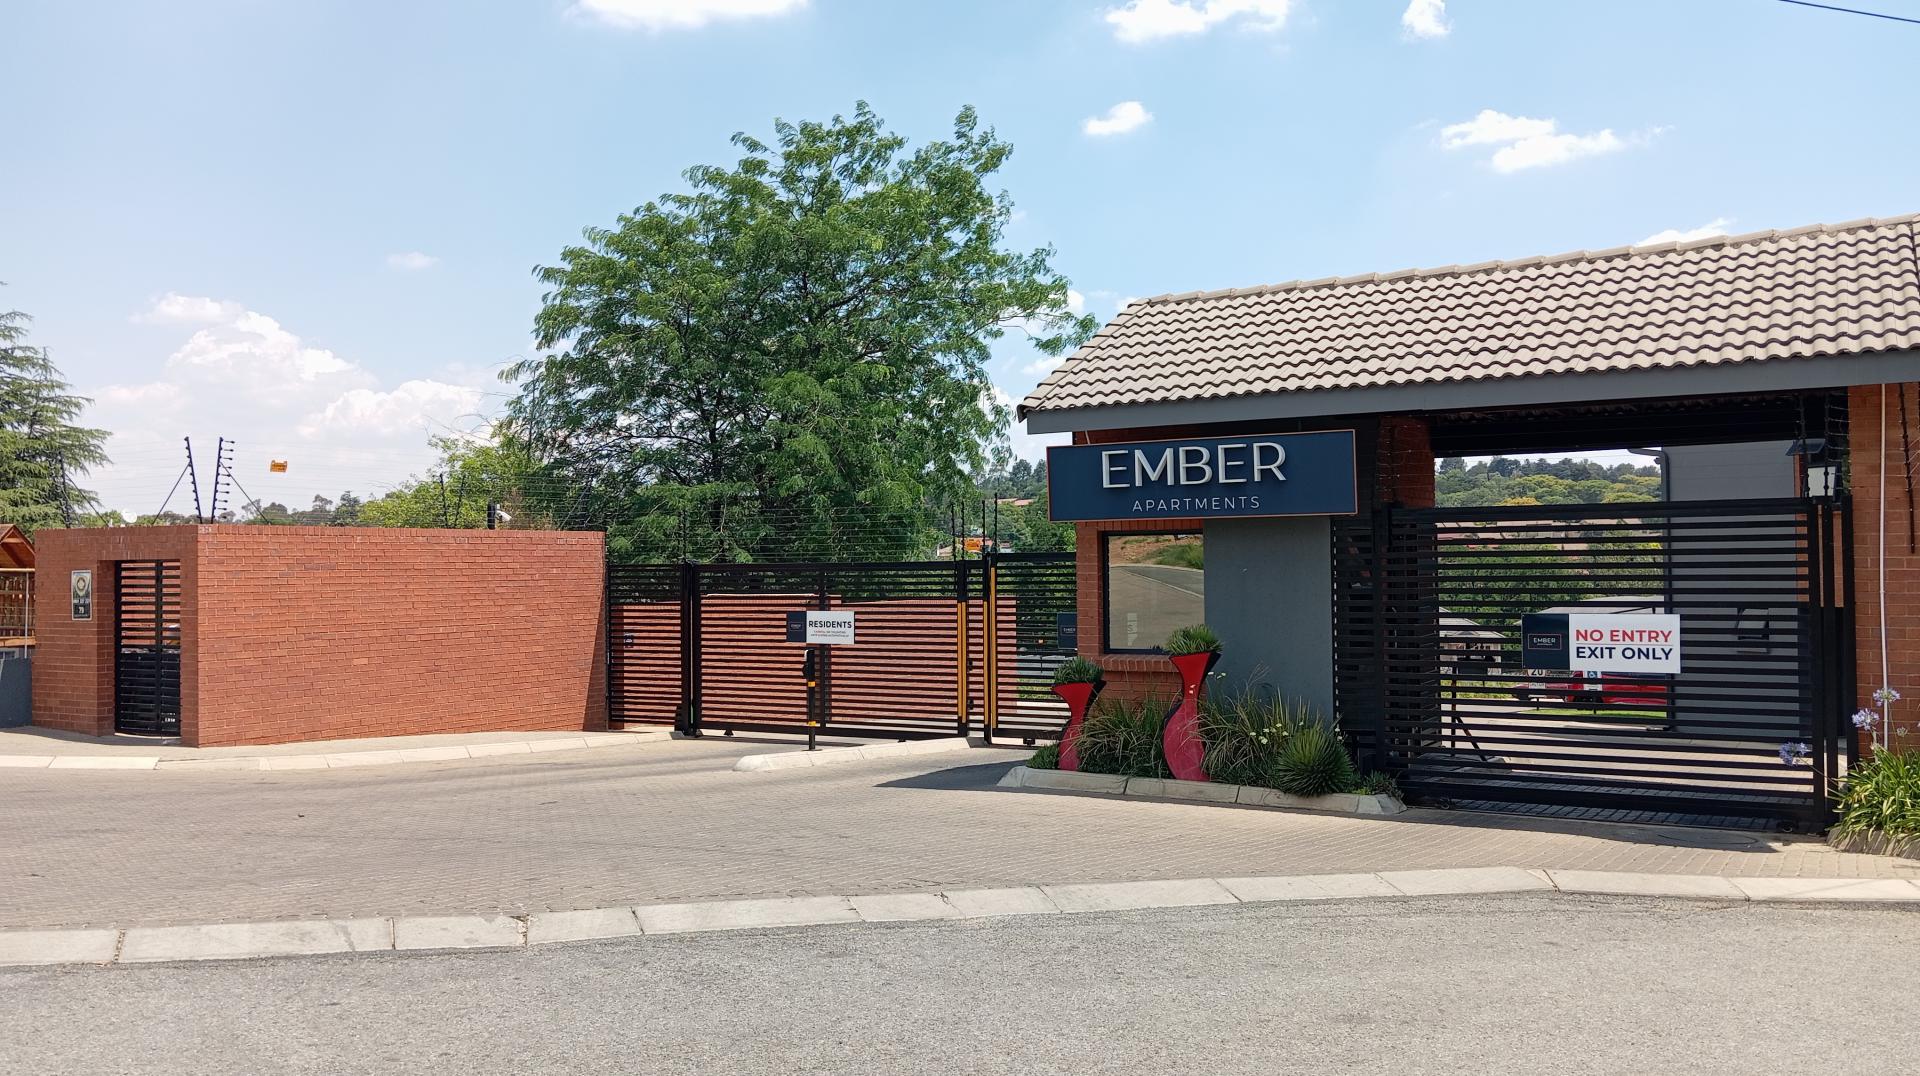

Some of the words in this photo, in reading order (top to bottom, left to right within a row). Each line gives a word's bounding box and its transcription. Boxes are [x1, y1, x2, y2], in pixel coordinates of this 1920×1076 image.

[1101, 442, 1287, 489] EMBER
[1132, 496, 1260, 512] APARTMENTS
[808, 620, 852, 629] RESIDENTS
[1575, 629, 1604, 642] NO
[1610, 629, 1673, 643] ENTRY
[1576, 646, 1616, 659] EXIT
[1621, 647, 1673, 660] ONLY
